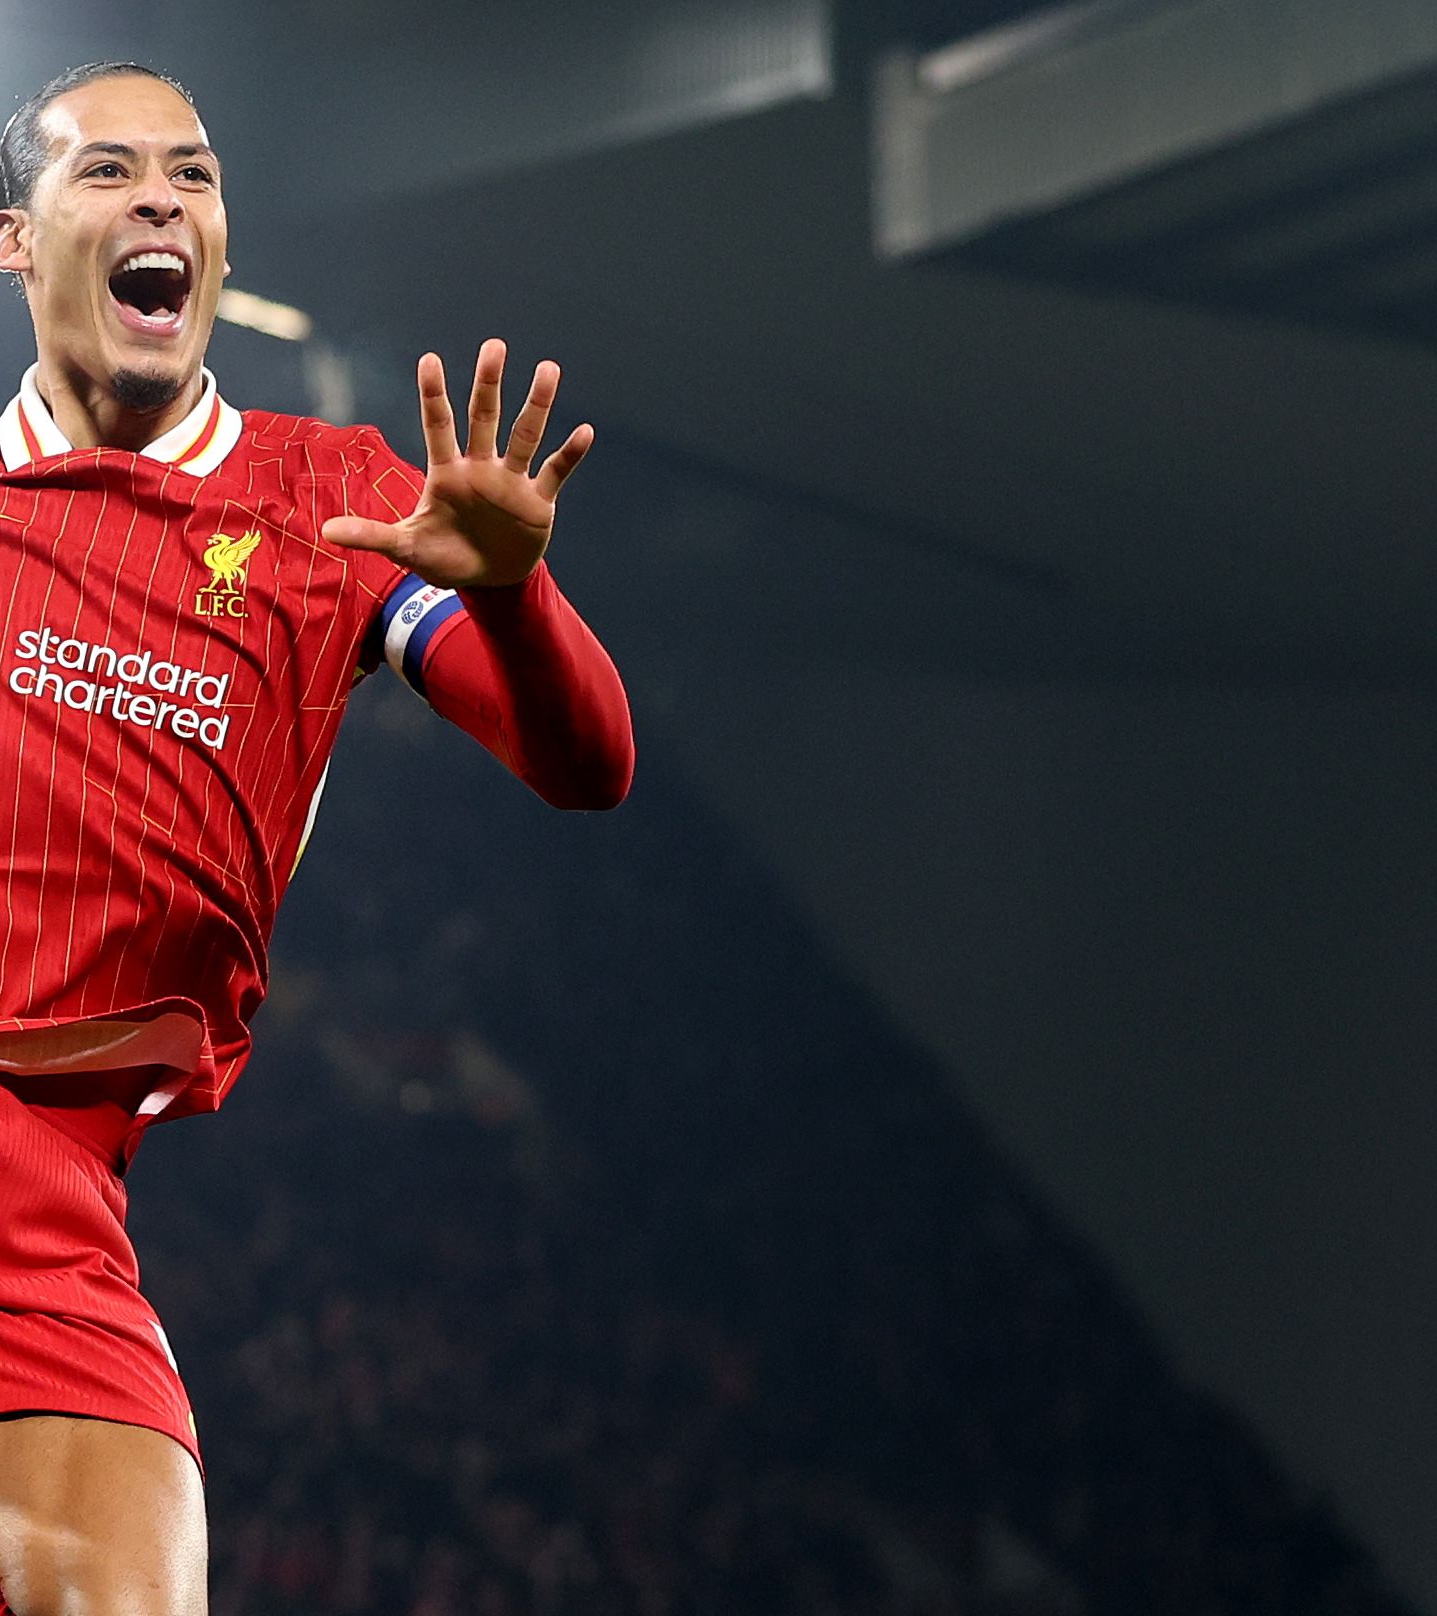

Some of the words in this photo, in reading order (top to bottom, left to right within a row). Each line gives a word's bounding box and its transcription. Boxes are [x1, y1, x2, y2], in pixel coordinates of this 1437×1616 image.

[194, 594, 249, 618] L.F.C.
[9, 664, 230, 750] chartered
[15, 627, 229, 709] standard
